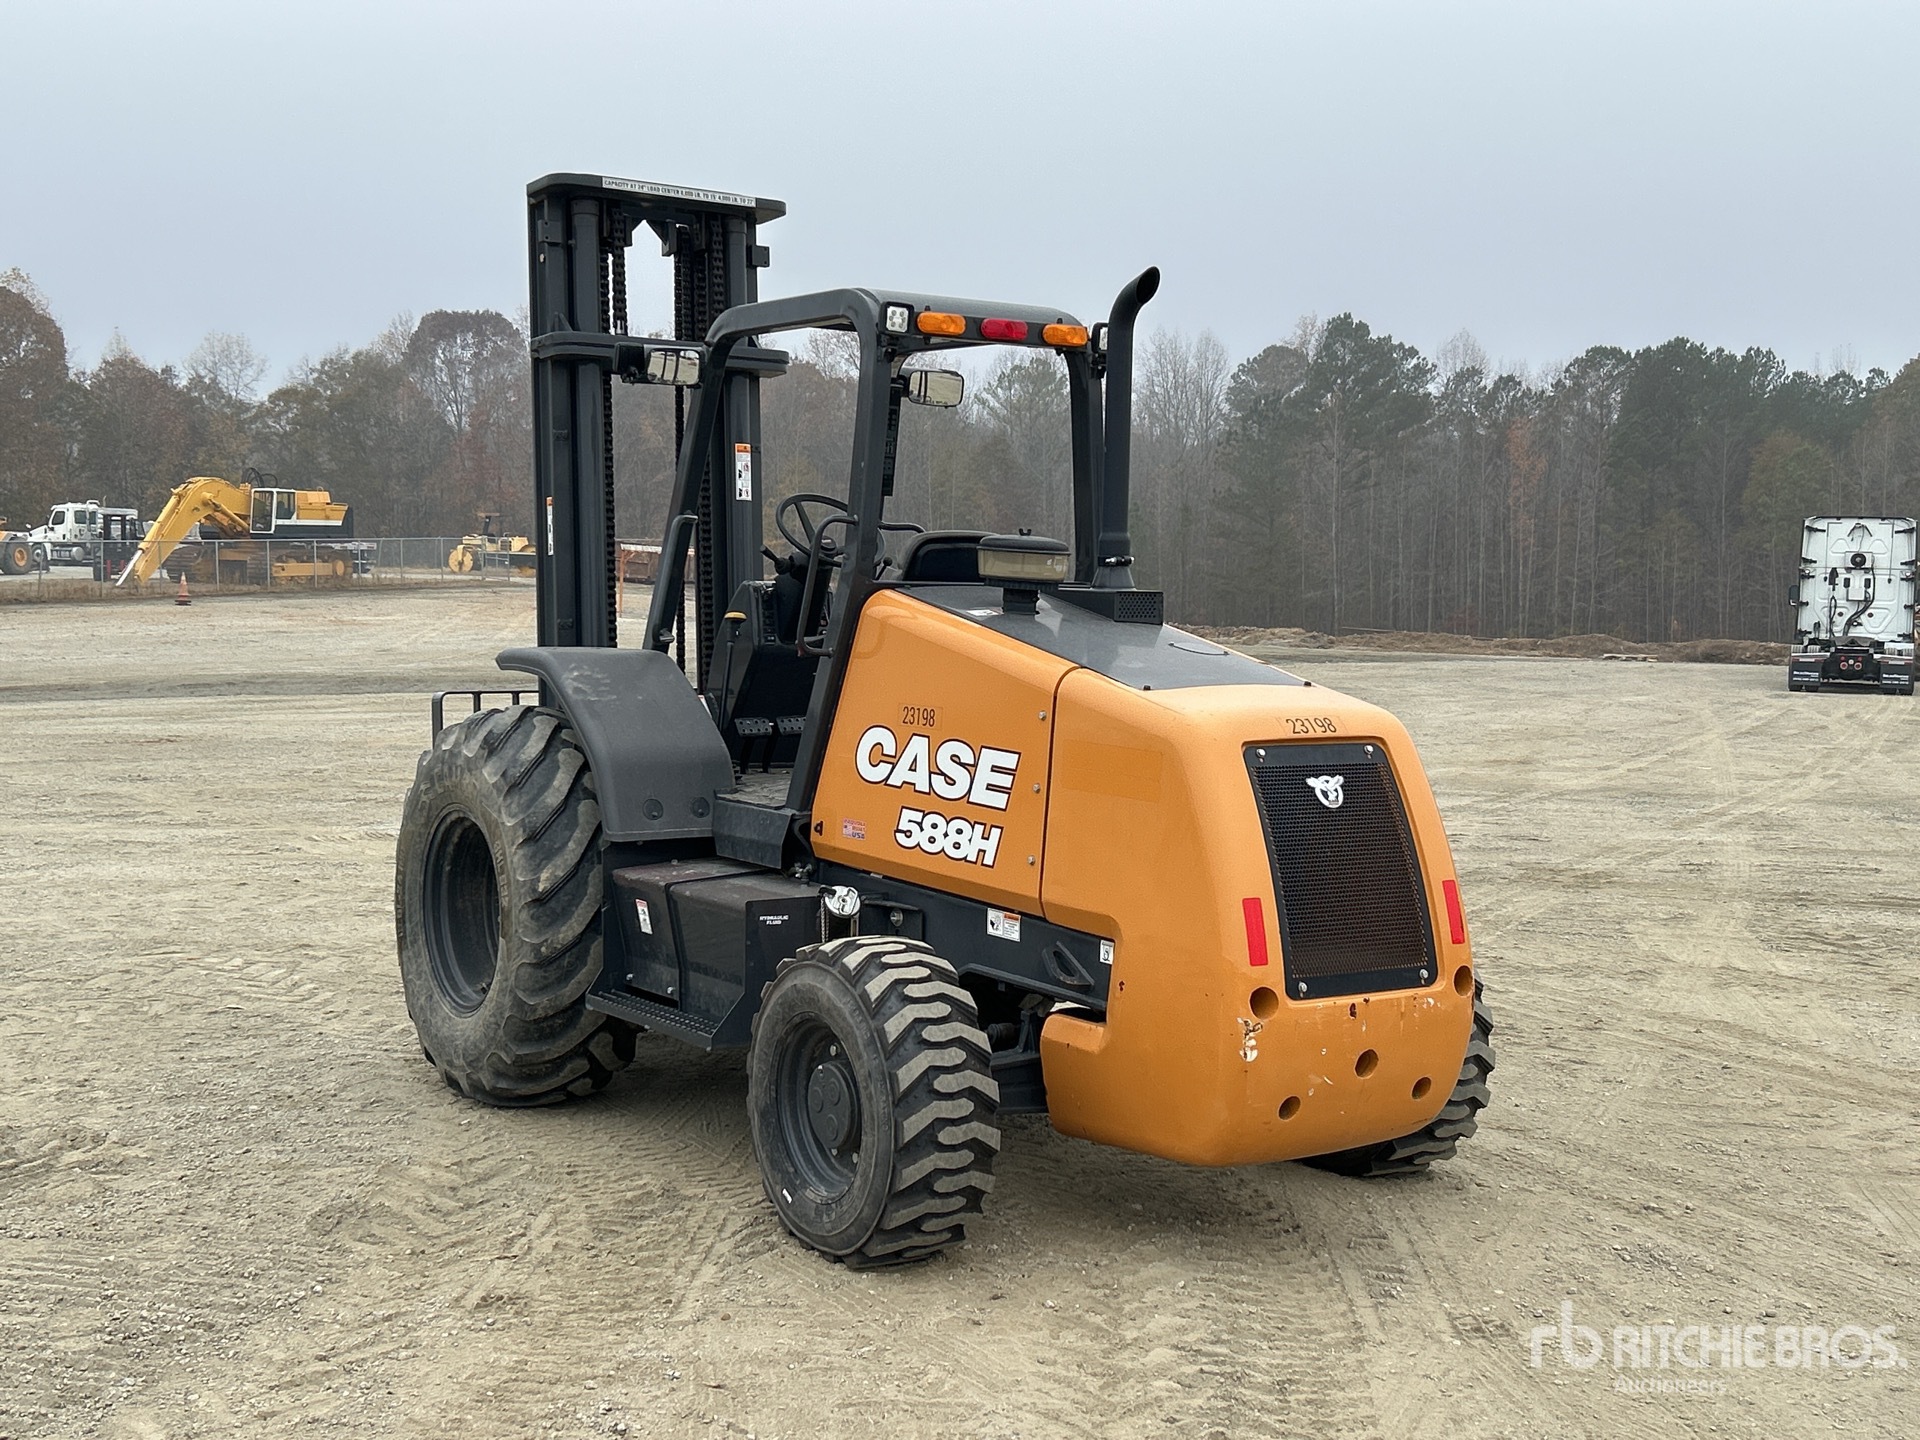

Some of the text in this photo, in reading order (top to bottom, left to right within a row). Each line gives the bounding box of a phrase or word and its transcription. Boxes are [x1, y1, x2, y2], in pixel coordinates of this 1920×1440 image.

[604, 180, 629, 189] CAPACITY
[661, 187, 680, 196] CENTER
[902, 706, 935, 727] 23198
[1286, 717, 1337, 734] 23198
[856, 725, 1021, 811] CASE
[894, 806, 1003, 868] 588H
